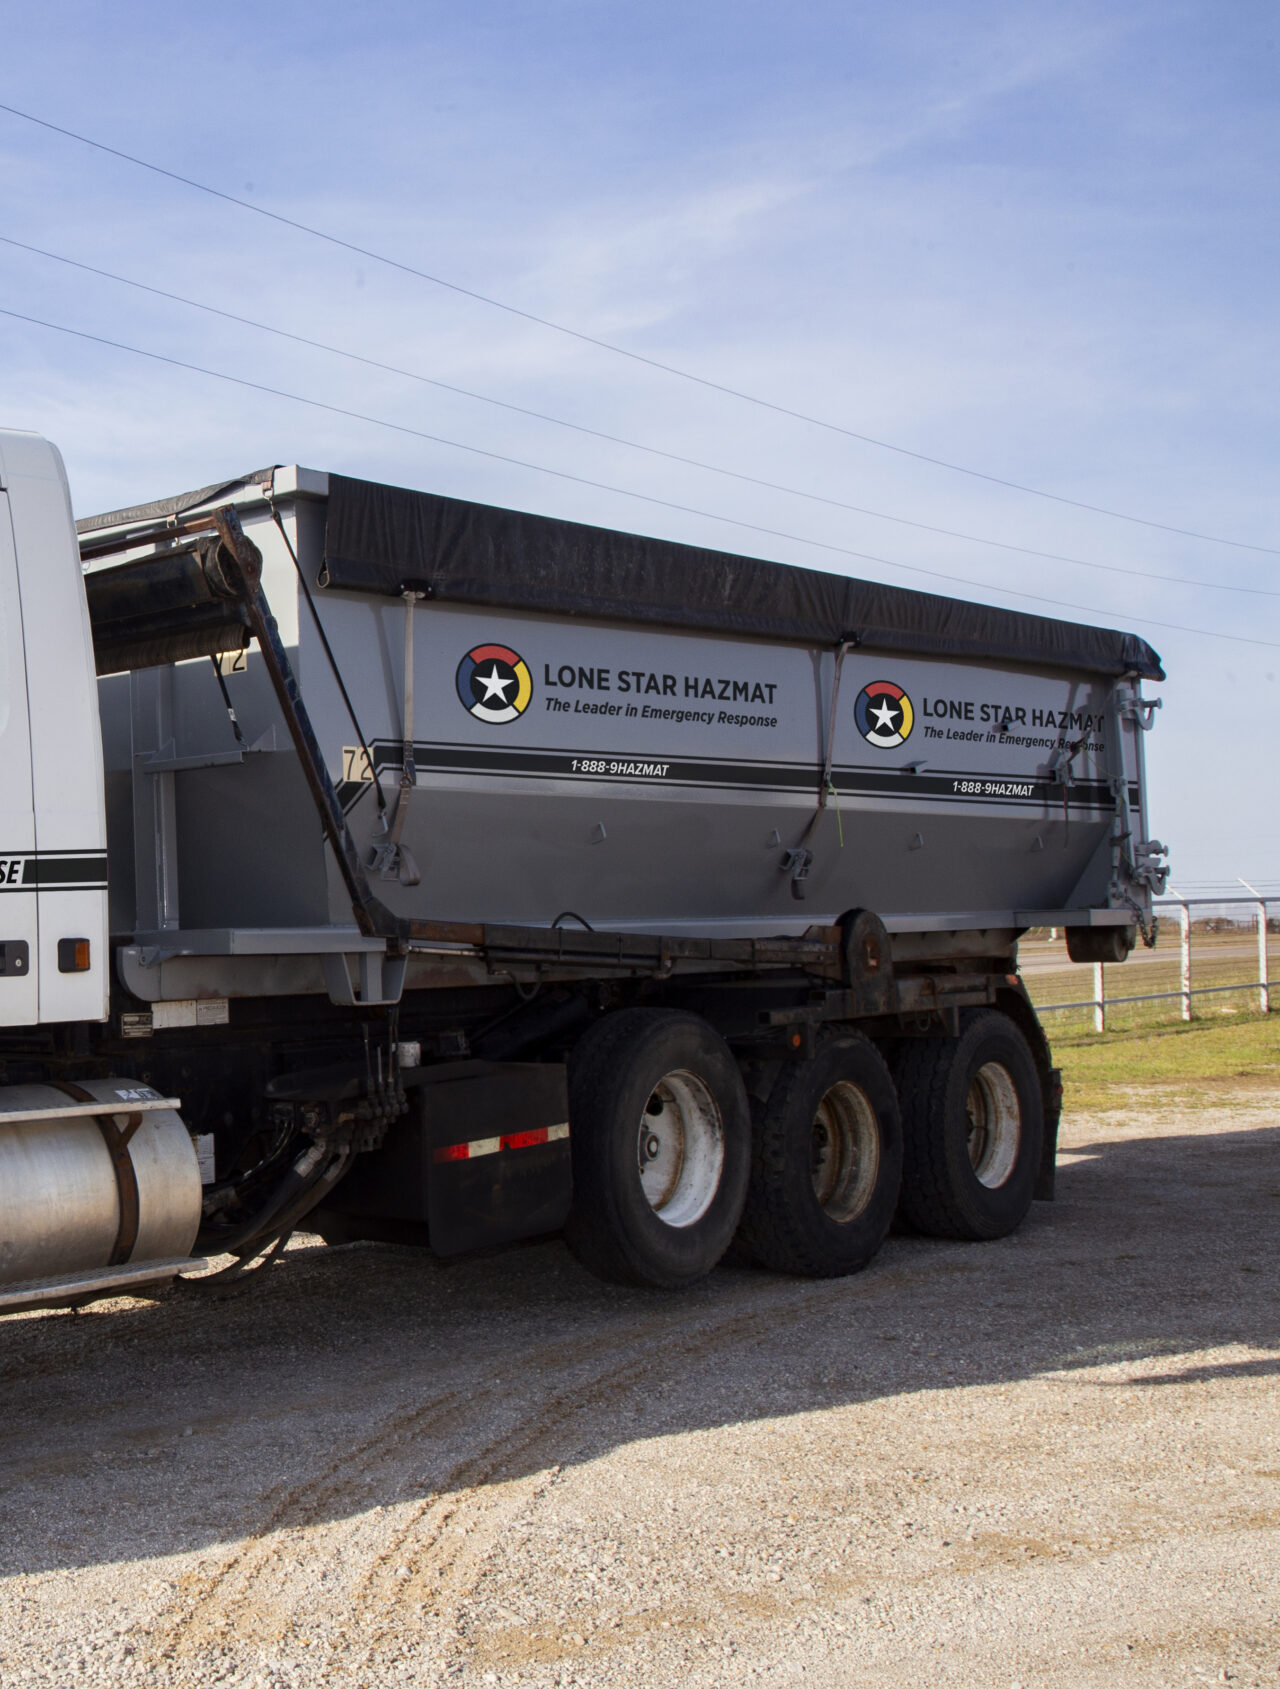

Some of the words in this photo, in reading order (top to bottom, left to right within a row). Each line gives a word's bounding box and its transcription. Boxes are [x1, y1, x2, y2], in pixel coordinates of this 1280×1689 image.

[544, 664, 610, 690] LONE
[617, 671, 677, 696] STAR
[684, 676, 777, 704] HAZMAT
[545, 698, 571, 712] The
[574, 700, 623, 717] Leader
[625, 703, 638, 717] in
[641, 705, 715, 724] Emergency
[717, 711, 778, 728] Response
[923, 698, 974, 721] LONE
[980, 704, 1027, 726] STAR
[1032, 709, 1104, 732] HAZMAT
[924, 726, 943, 739] The
[946, 728, 984, 742] Leader
[986, 731, 996, 743] in
[999, 732, 1056, 750] Emergency
[344, 749, 372, 780] 72
[571, 760, 669, 777] 1-888-9HAZMAT
[952, 780, 1034, 797] 1-888-9HAZMAT
